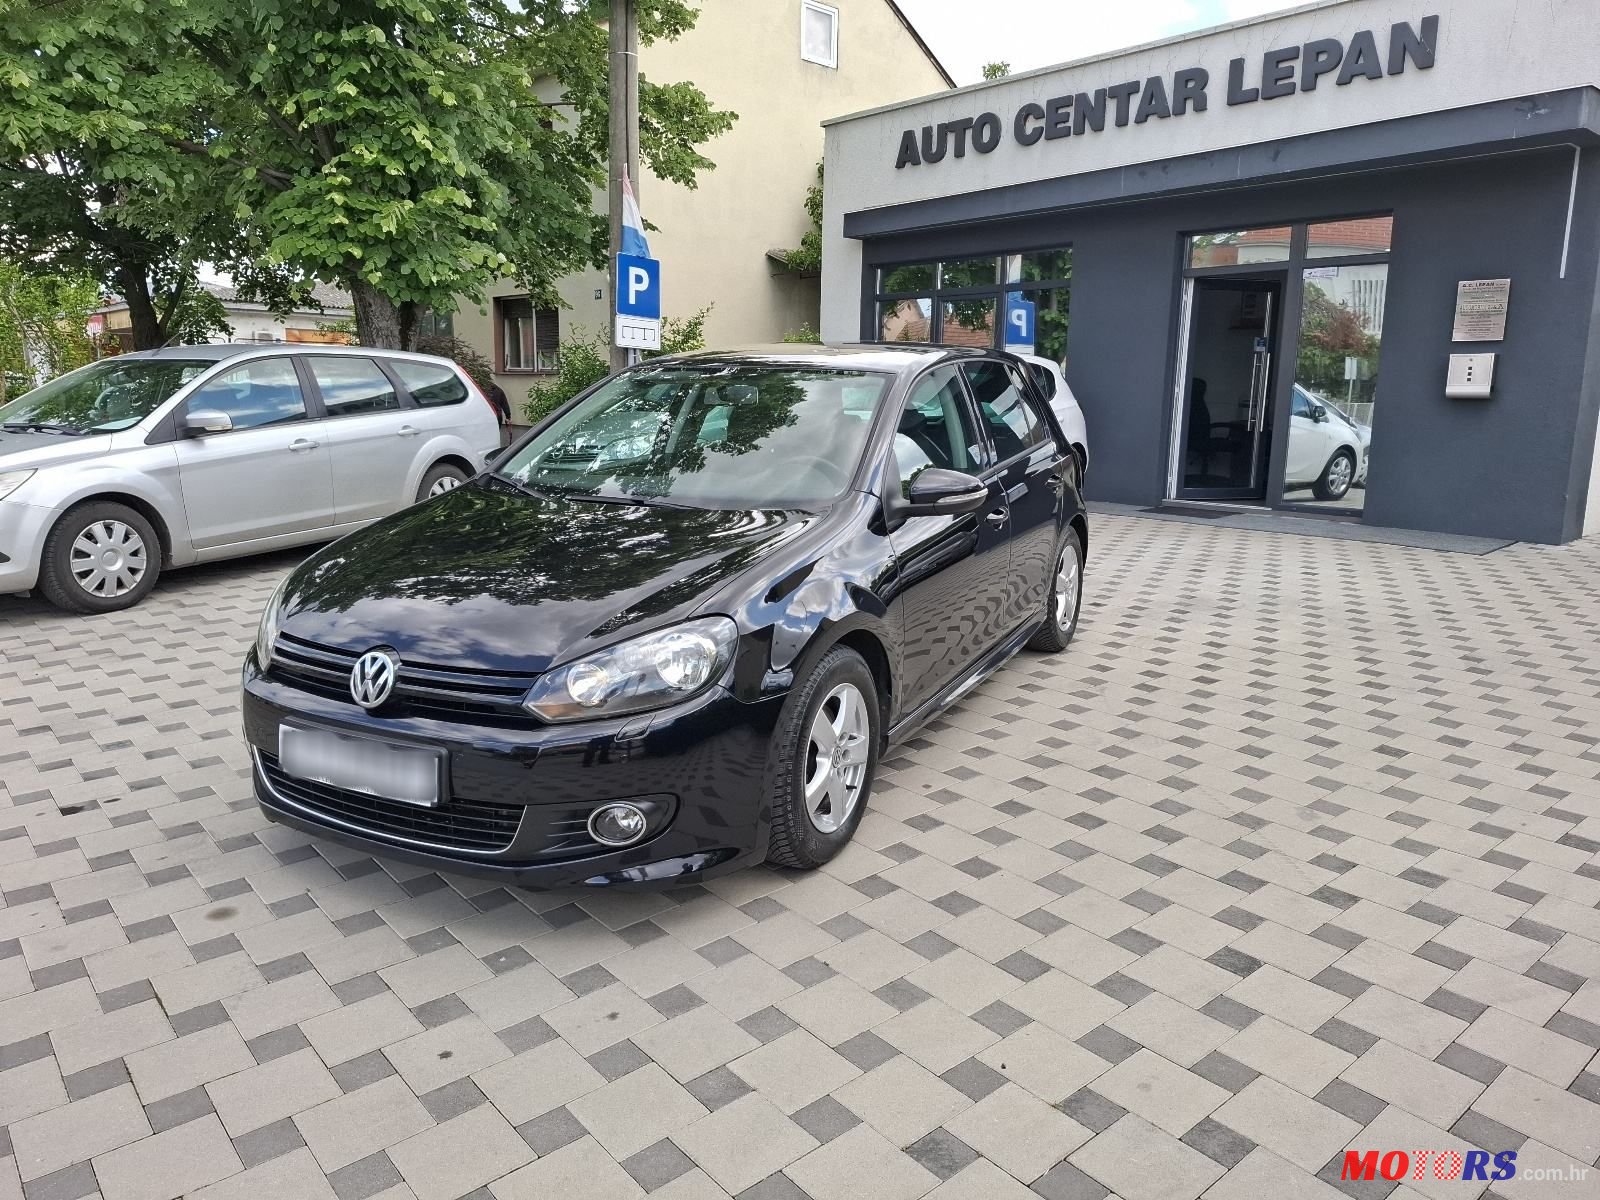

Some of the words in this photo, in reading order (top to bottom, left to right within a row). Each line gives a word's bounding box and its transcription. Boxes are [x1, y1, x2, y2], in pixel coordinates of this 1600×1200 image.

[895, 112, 1003, 169] AUTO
[1013, 67, 1209, 146] CENTAR
[1226, 14, 1439, 106] LEPAN
[628, 266, 650, 305] P
